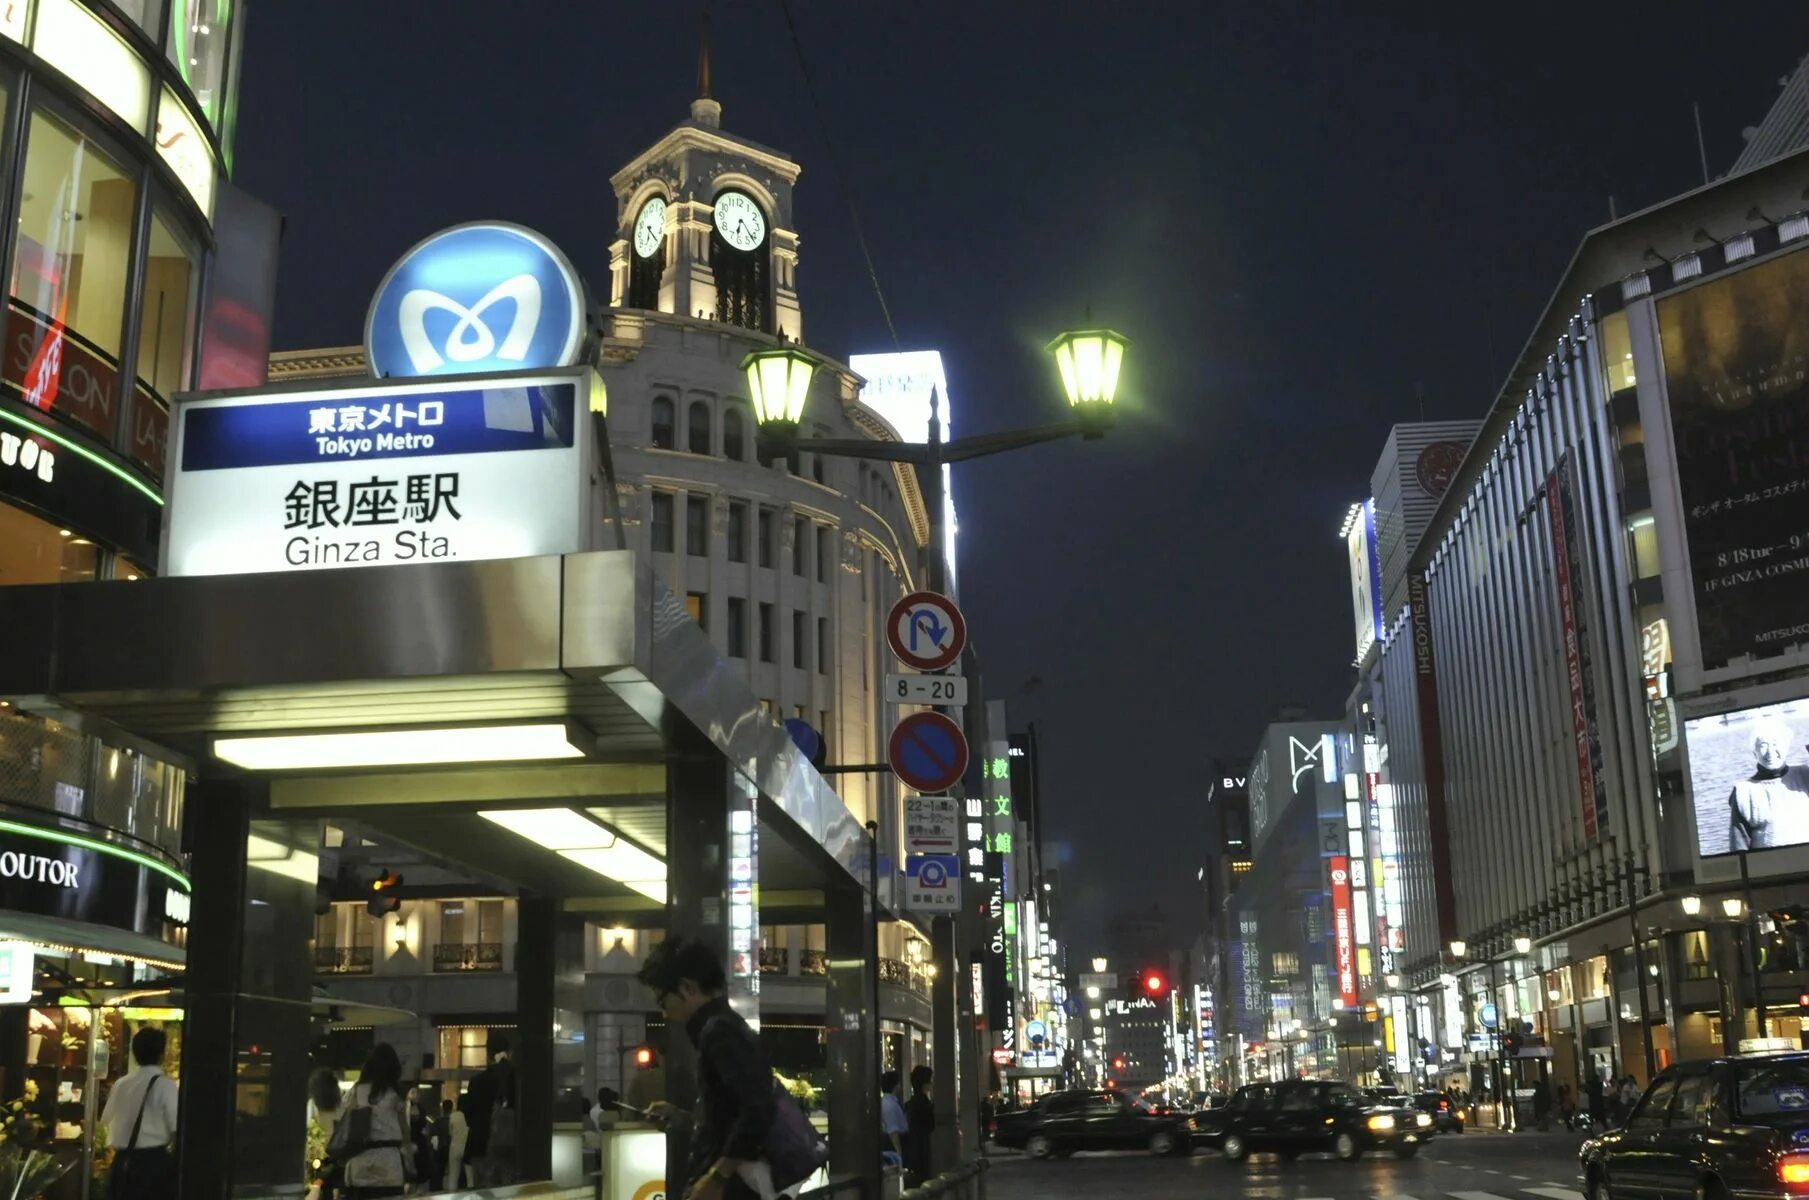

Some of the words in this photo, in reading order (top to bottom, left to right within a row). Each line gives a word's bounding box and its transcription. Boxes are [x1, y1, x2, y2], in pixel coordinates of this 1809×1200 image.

[14, 333, 111, 416] SON
[308, 401, 444, 434] 東京メトロ
[316, 436, 372, 457] Tokyo
[377, 432, 434, 451] Metro
[284, 472, 462, 530] 銀座駅
[1762, 479, 1809, 499] コスメティ
[285, 535, 380, 566] Ginza
[394, 530, 457, 561] Sta.
[1722, 569, 1764, 588] GINZA
[1410, 574, 1431, 674] MITSUKOSHI
[1223, 777, 1246, 788] BV
